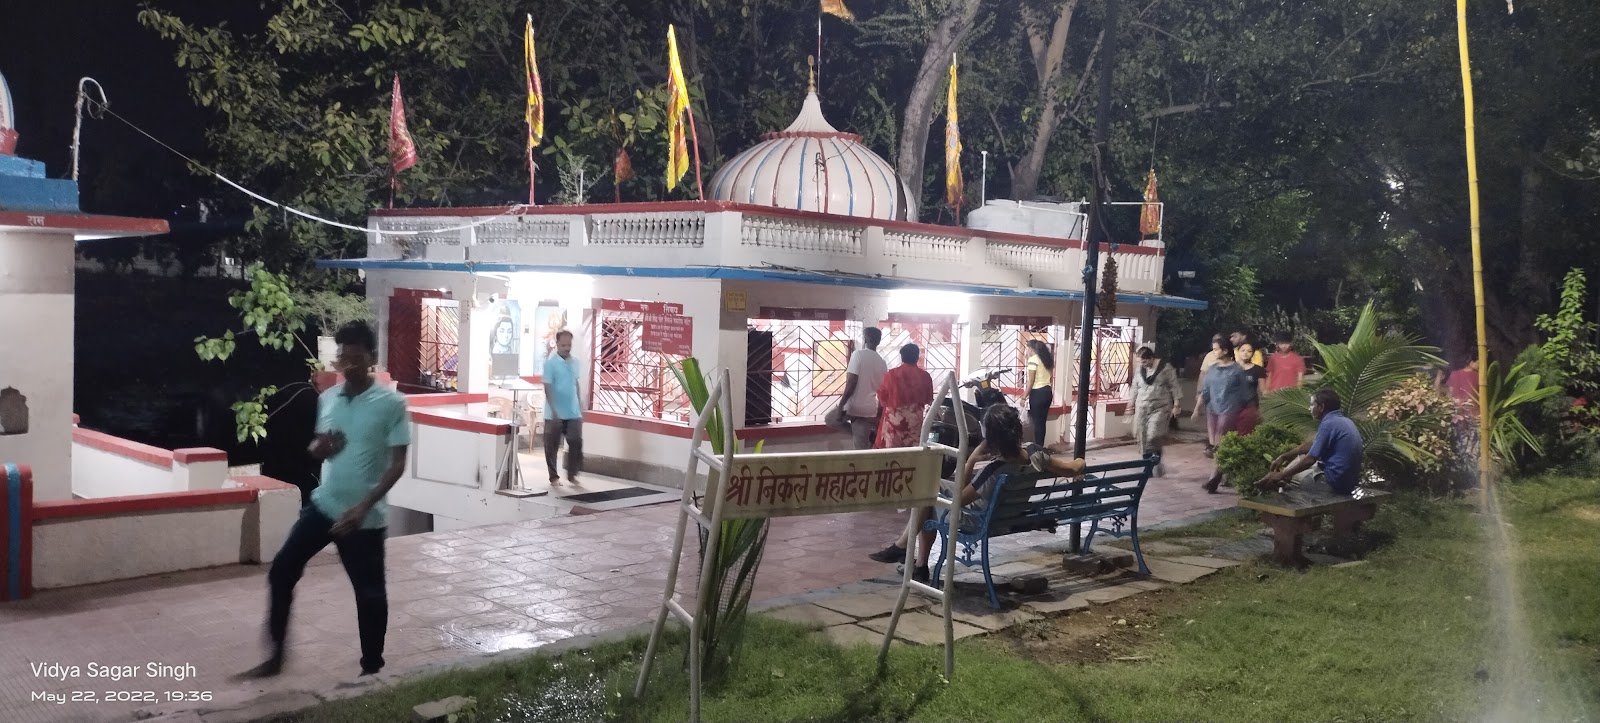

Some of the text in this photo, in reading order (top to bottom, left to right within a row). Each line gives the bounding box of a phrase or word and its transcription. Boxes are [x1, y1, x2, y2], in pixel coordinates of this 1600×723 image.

[725, 460, 916, 506] श्री निकले महादेव मंदिर
